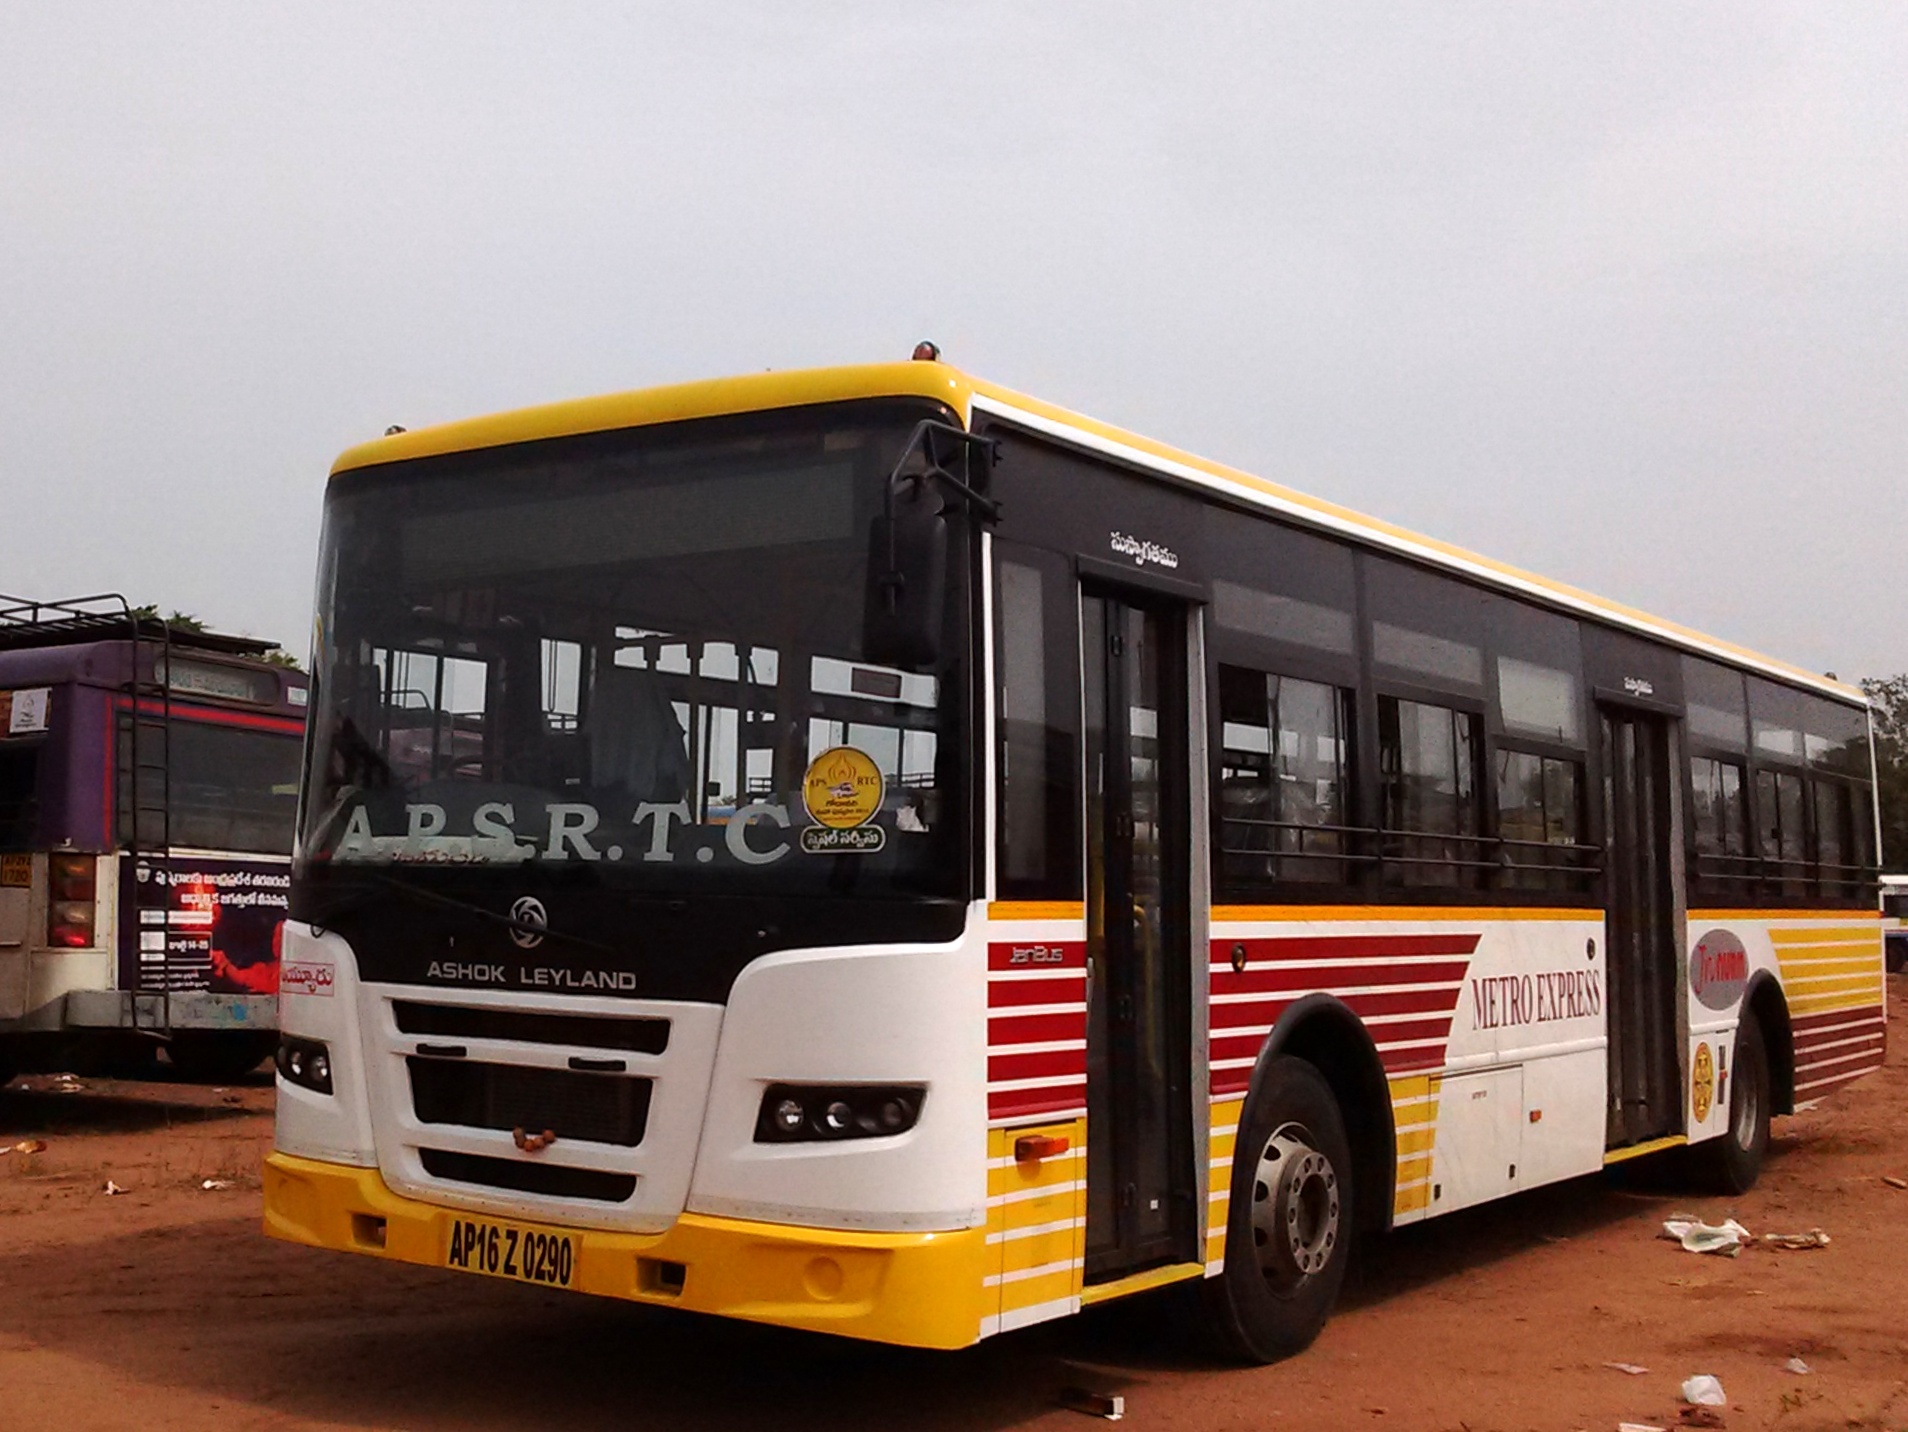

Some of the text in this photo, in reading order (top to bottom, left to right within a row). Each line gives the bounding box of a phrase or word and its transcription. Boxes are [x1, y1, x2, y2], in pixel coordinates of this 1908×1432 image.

[857, 776, 878, 786] RTC
[427, 961, 637, 990] ASHOK LEYLAND
[1472, 969, 1601, 1031] METRO EXPRESS
[449, 1220, 572, 1286] AP16 Z 0290
